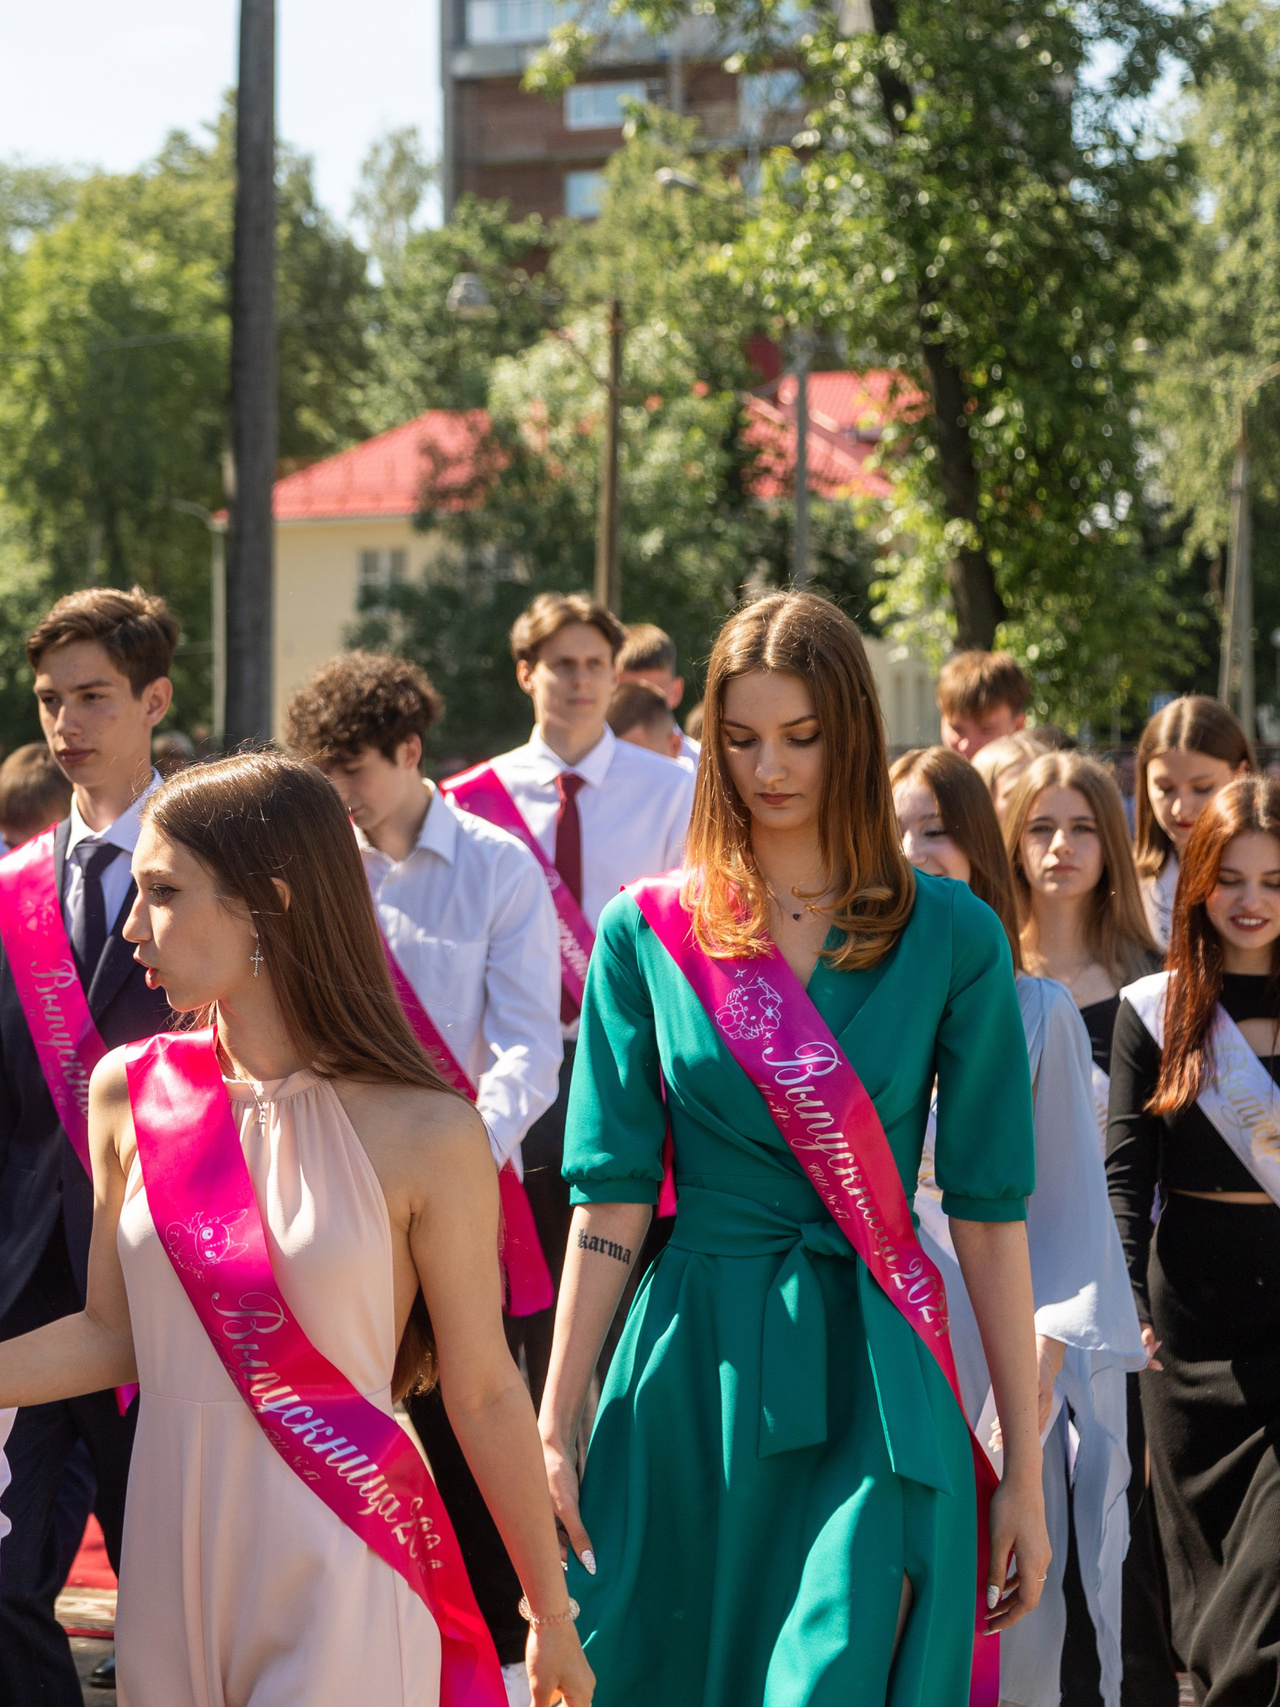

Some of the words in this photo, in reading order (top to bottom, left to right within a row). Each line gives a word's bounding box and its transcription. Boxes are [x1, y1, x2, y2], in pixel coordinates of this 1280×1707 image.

[577, 1228, 632, 1265] karma
[762, 1041, 899, 1269] Выпускница
[891, 1257, 950, 1337] 2024
[211, 1292, 401, 1523] Выпускница
